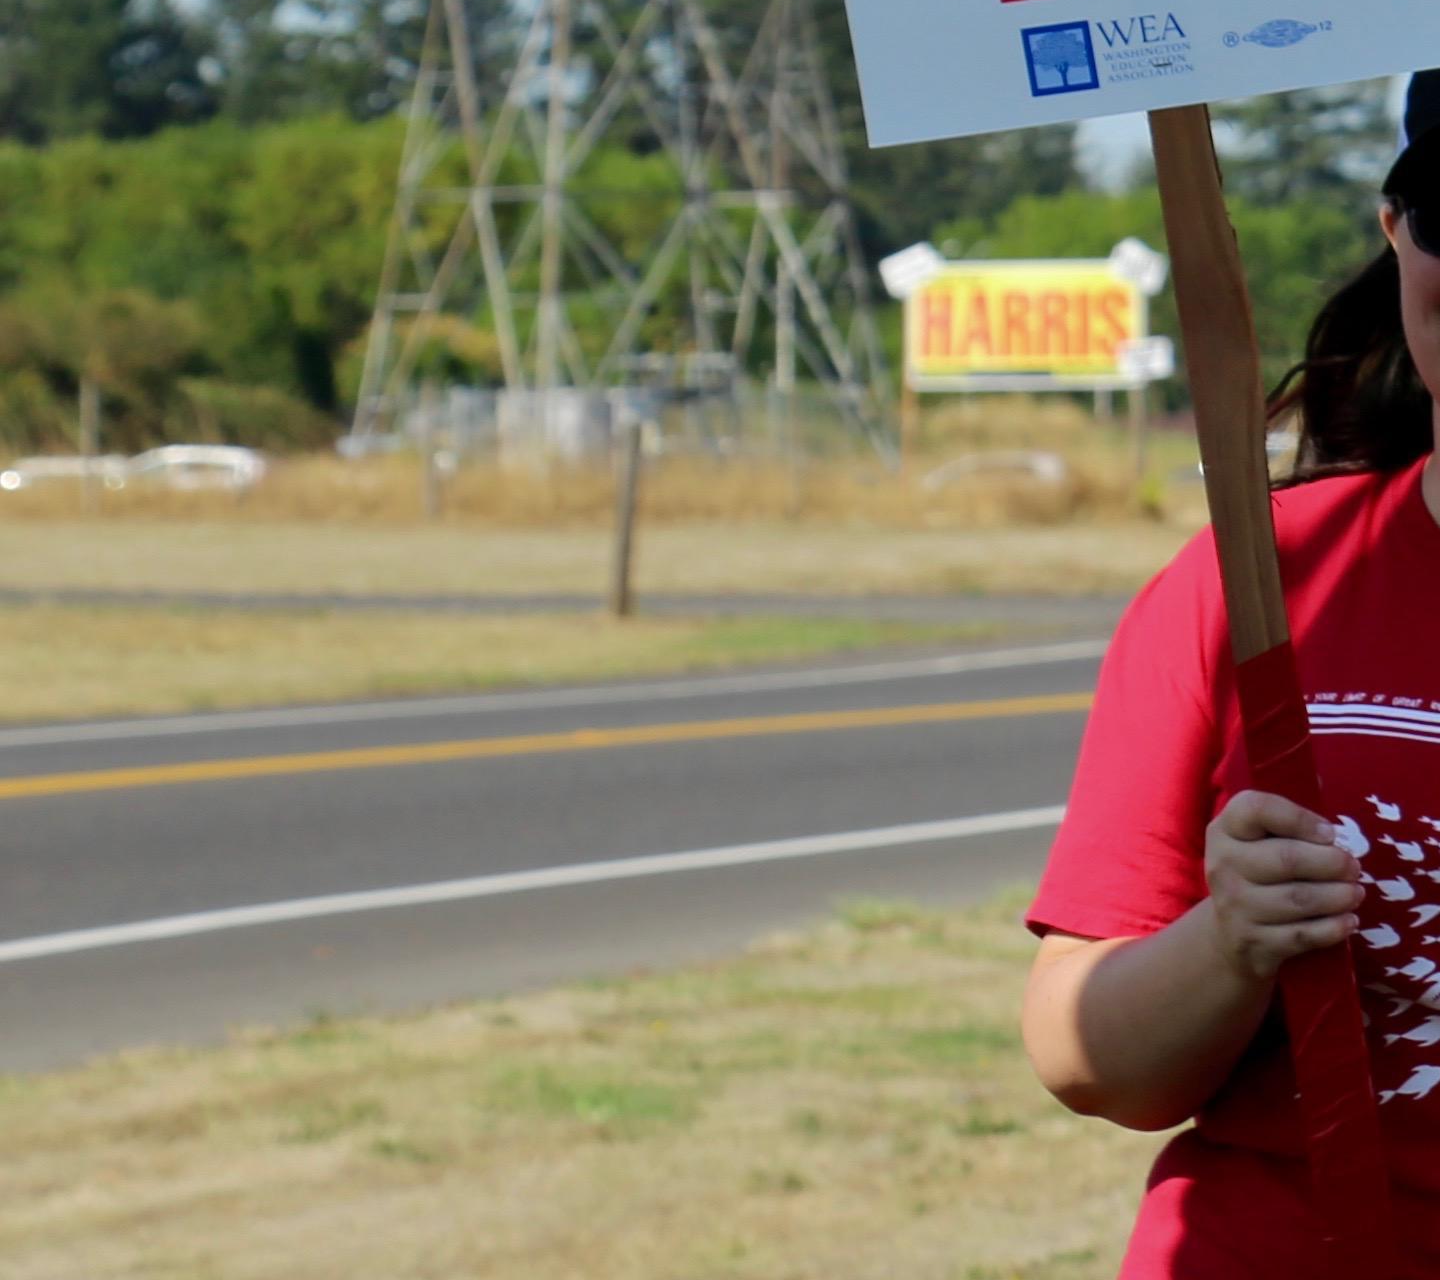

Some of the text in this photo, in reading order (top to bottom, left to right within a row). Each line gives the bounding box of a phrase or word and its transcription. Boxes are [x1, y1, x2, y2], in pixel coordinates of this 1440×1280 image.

[1096, 12, 1187, 48] WEA
[1102, 41, 1192, 61] WASHINGTON
[920, 287, 1130, 358] HARRIS
